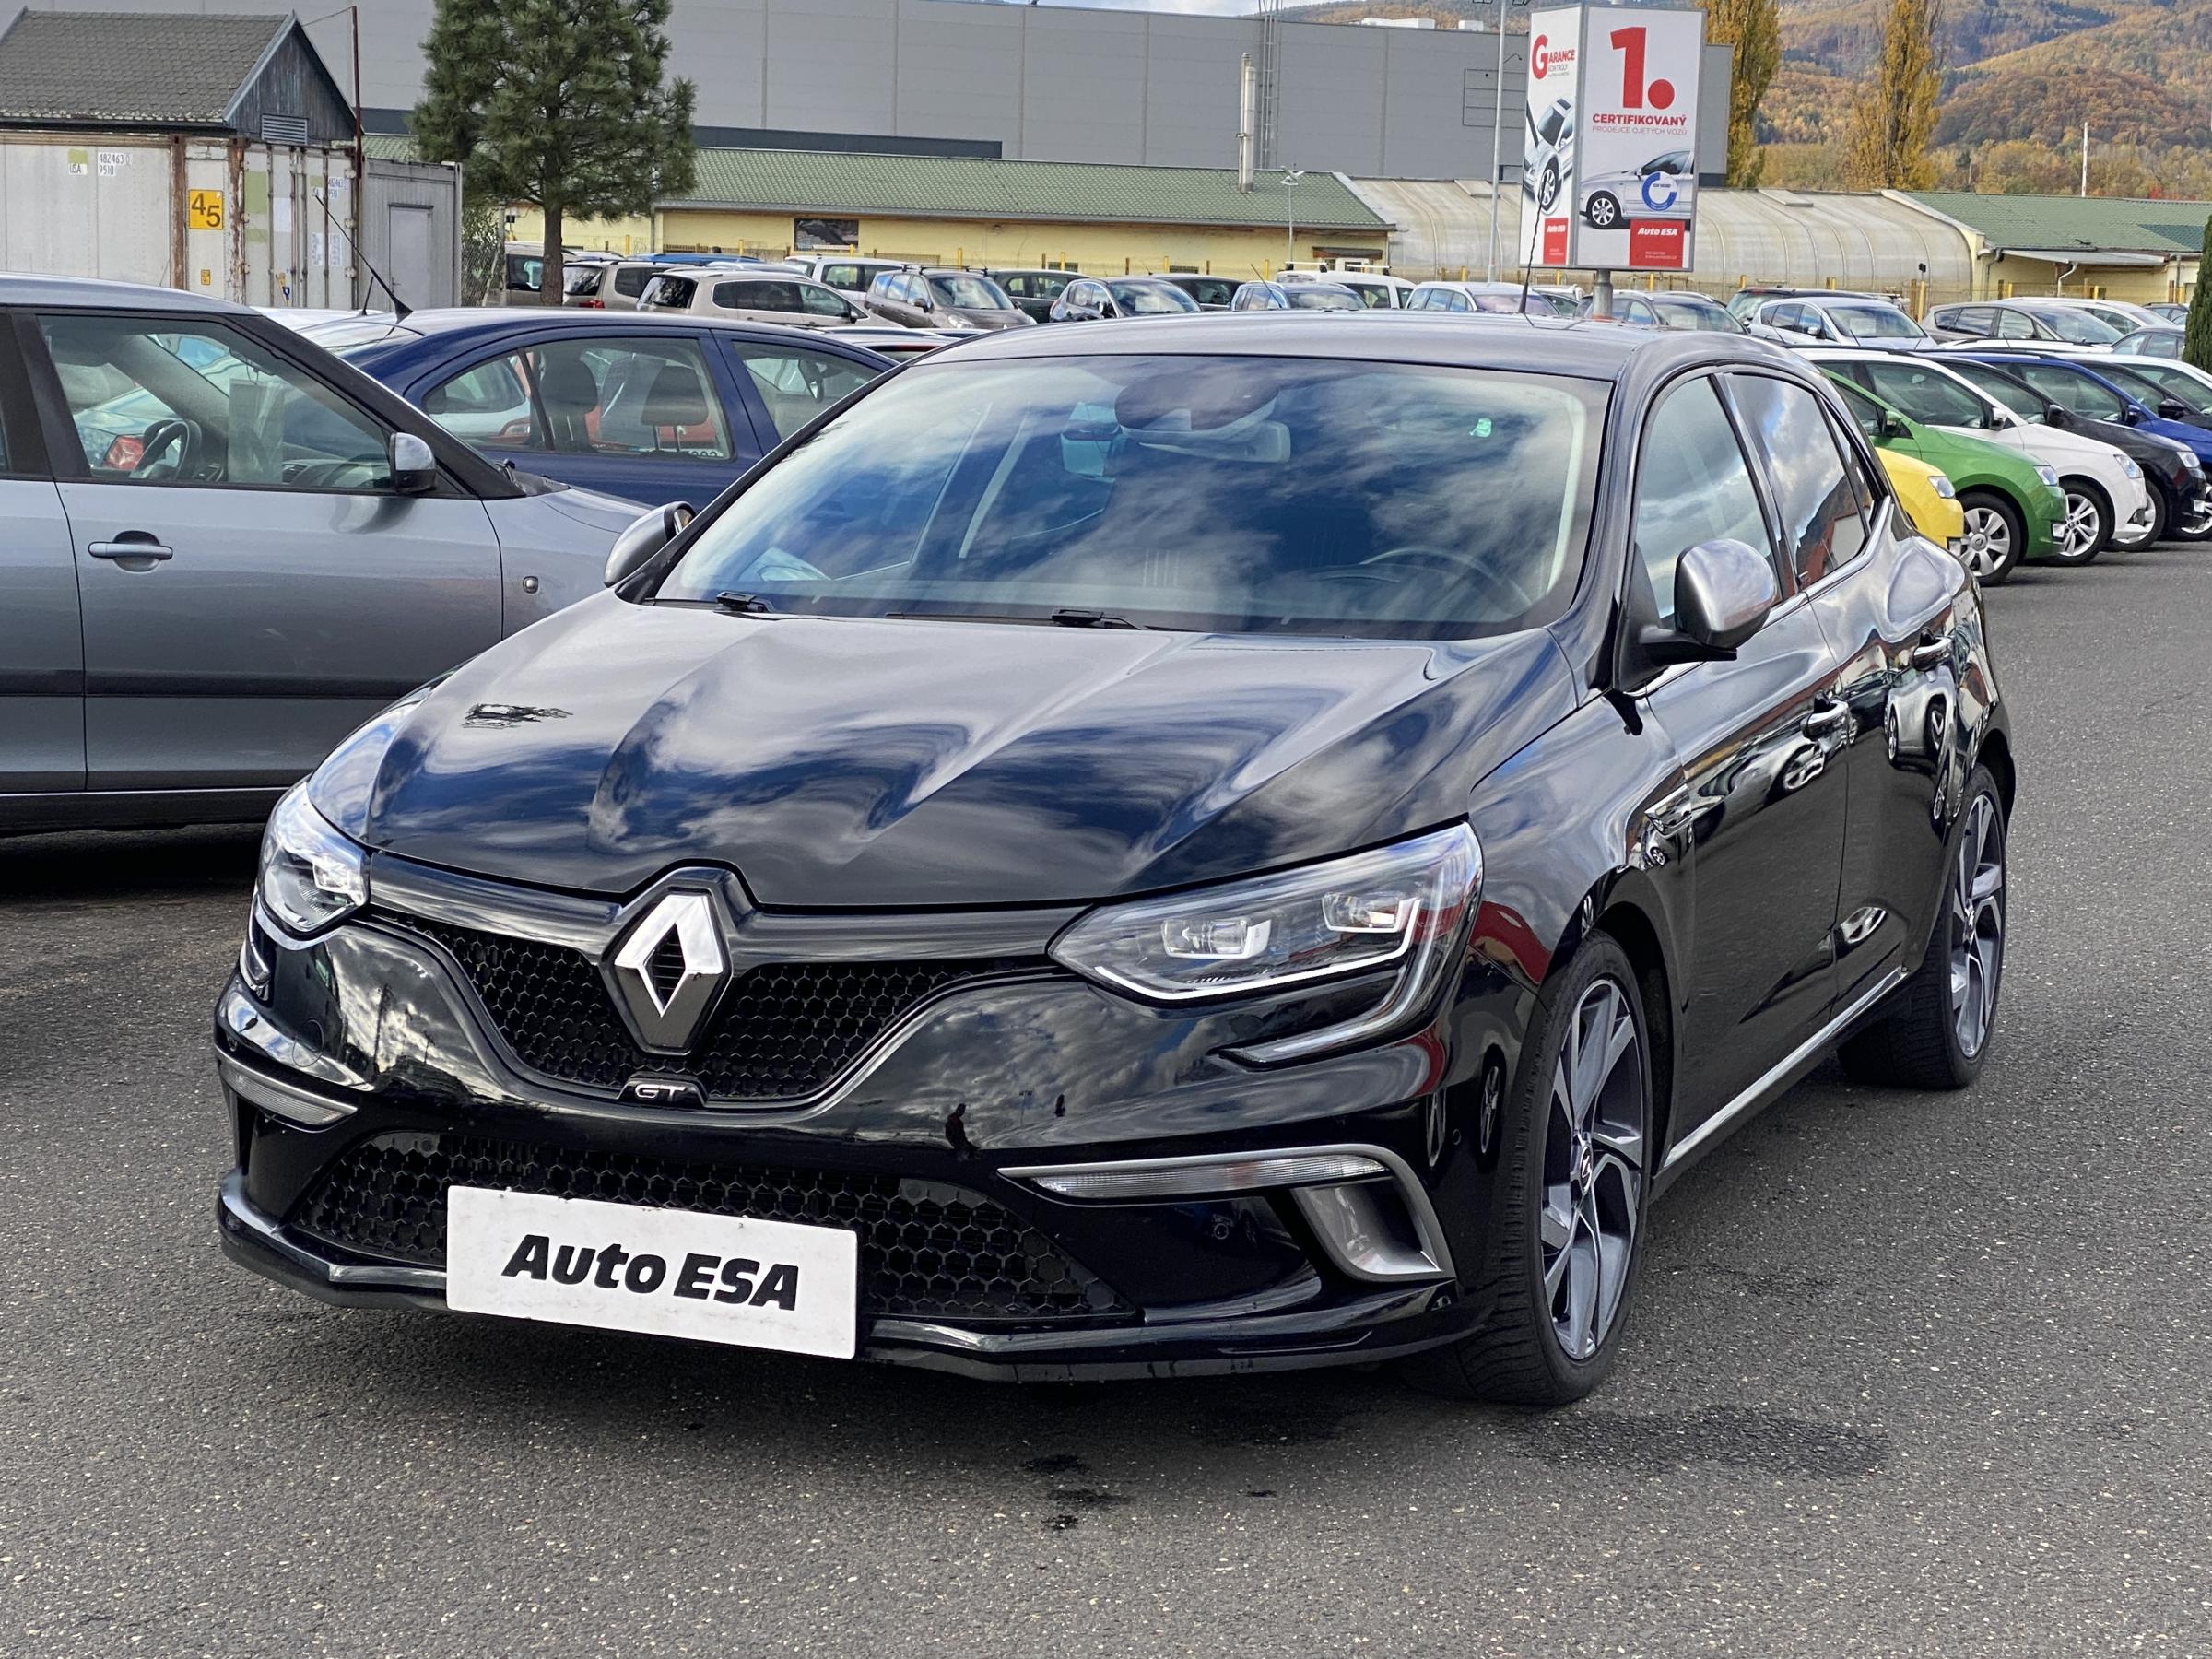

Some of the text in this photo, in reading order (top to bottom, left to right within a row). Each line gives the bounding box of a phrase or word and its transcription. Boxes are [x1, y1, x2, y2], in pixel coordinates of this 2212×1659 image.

[1532, 34, 1575, 80] GARANCE
[1610, 27, 1675, 110] 1.
[1593, 113, 1687, 126] CERTIFIKOVANÝ
[1637, 227, 1678, 236] Auto ESA
[635, 1083, 687, 1101] GT
[500, 1234, 799, 1312] Auto ESA
